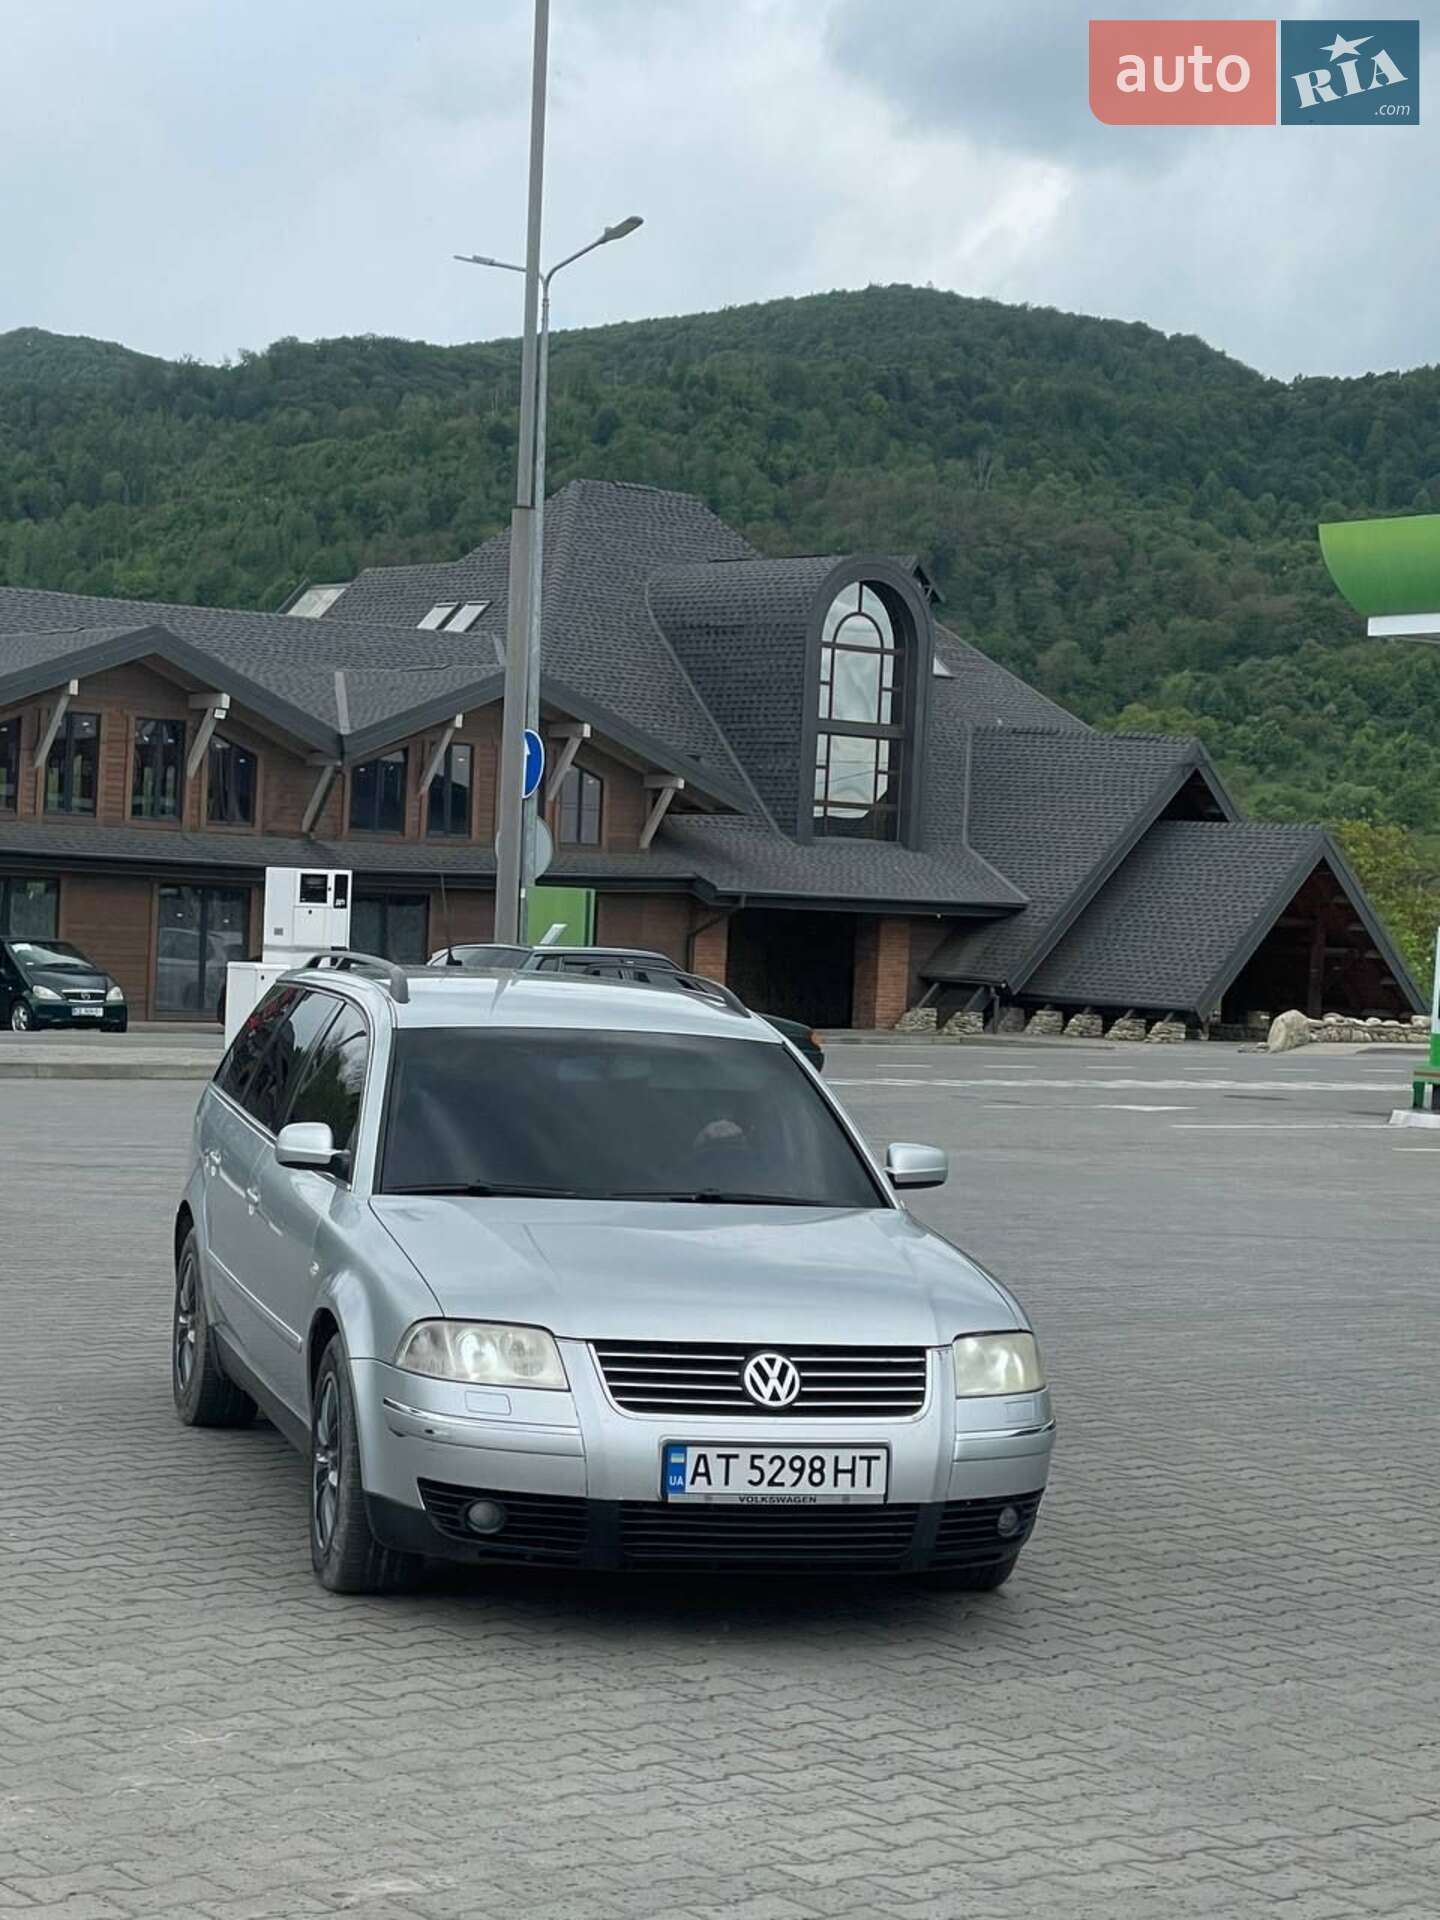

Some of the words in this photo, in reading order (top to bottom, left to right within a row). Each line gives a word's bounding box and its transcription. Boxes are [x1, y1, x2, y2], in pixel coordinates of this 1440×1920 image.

[690, 1454, 740, 1486] AT
[748, 1455, 826, 1488] 5298
[834, 1456, 881, 1488] HT
[669, 1476, 684, 1486] UA
[738, 1495, 817, 1504] VOLKSWAGEN
